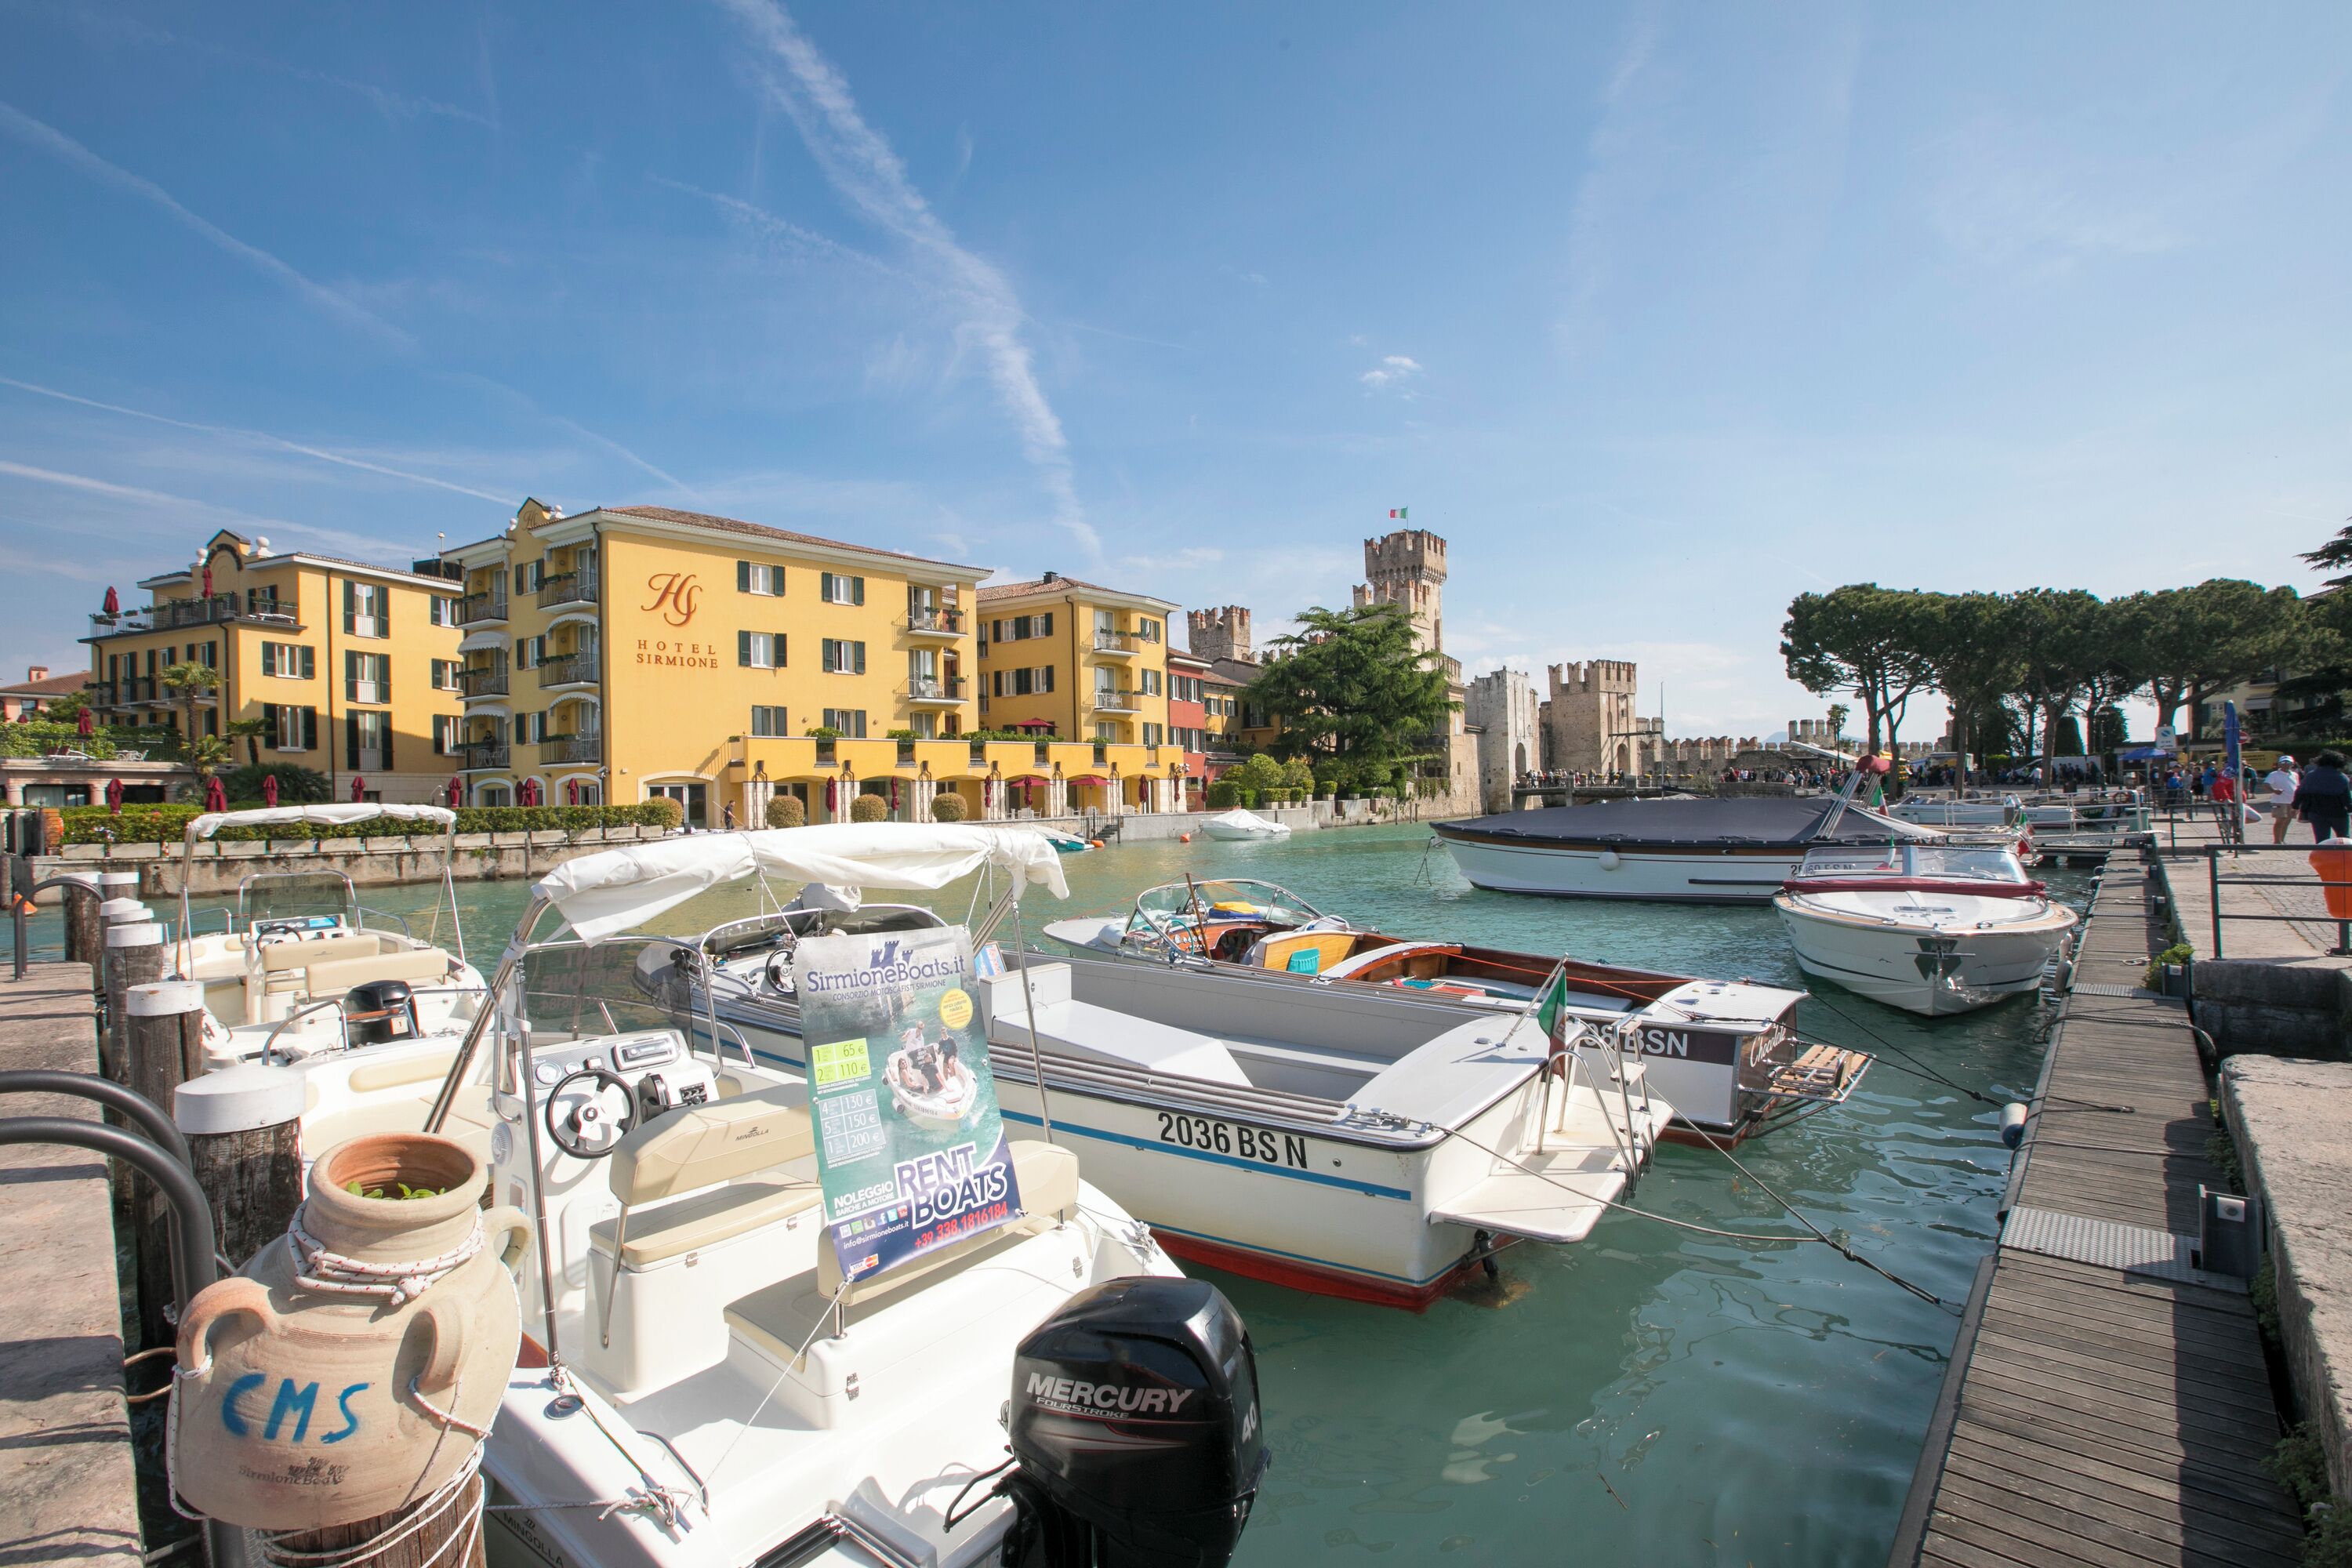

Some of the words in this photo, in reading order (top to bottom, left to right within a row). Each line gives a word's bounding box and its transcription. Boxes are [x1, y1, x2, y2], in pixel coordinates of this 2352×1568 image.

[641, 573, 702, 627] HS
[637, 639, 716, 655] HOTEL
[637, 653, 718, 668] SIRMIONE
[807, 954, 966, 993] SirmioneBoats.it
[833, 989, 869, 1001] CONSORZIO
[870, 983, 915, 998] MOTOSCAFISTI
[916, 979, 946, 991] SIRMIONE
[843, 1044, 855, 1057] 65
[858, 1045, 865, 1054] €
[1624, 1029, 1688, 1057] BSN
[817, 1069, 824, 1081] 2
[840, 1062, 858, 1076] 110
[861, 1063, 867, 1073] €
[822, 1102, 829, 1114] 4
[844, 1094, 862, 1109] 130
[865, 1095, 873, 1105] €
[735, 1128, 769, 1142] MINGOLLA
[824, 1121, 831, 1134] 5
[848, 1112, 866, 1128] 150
[869, 1113, 877, 1123] €
[1157, 1112, 1231, 1154] 2036
[850, 1131, 869, 1148] 200
[873, 1132, 880, 1142] €
[897, 1145, 974, 1198] RENT
[834, 1181, 894, 1209] NOLEGGIO
[836, 1203, 861, 1217] BARCHE
[868, 1192, 895, 1206] MOTORE
[913, 1164, 1005, 1222] BOATS
[844, 1221, 909, 1250] info@sirmioneboats.it
[915, 1230, 934, 1248] +39
[936, 1201, 1008, 1241] 338.1816184
[1026, 1372, 1194, 1414] MERCURY
[221, 1373, 370, 1444] CMS
[1241, 1401, 1258, 1444] 40
[503, 1511, 564, 1568] MINGOLLA
